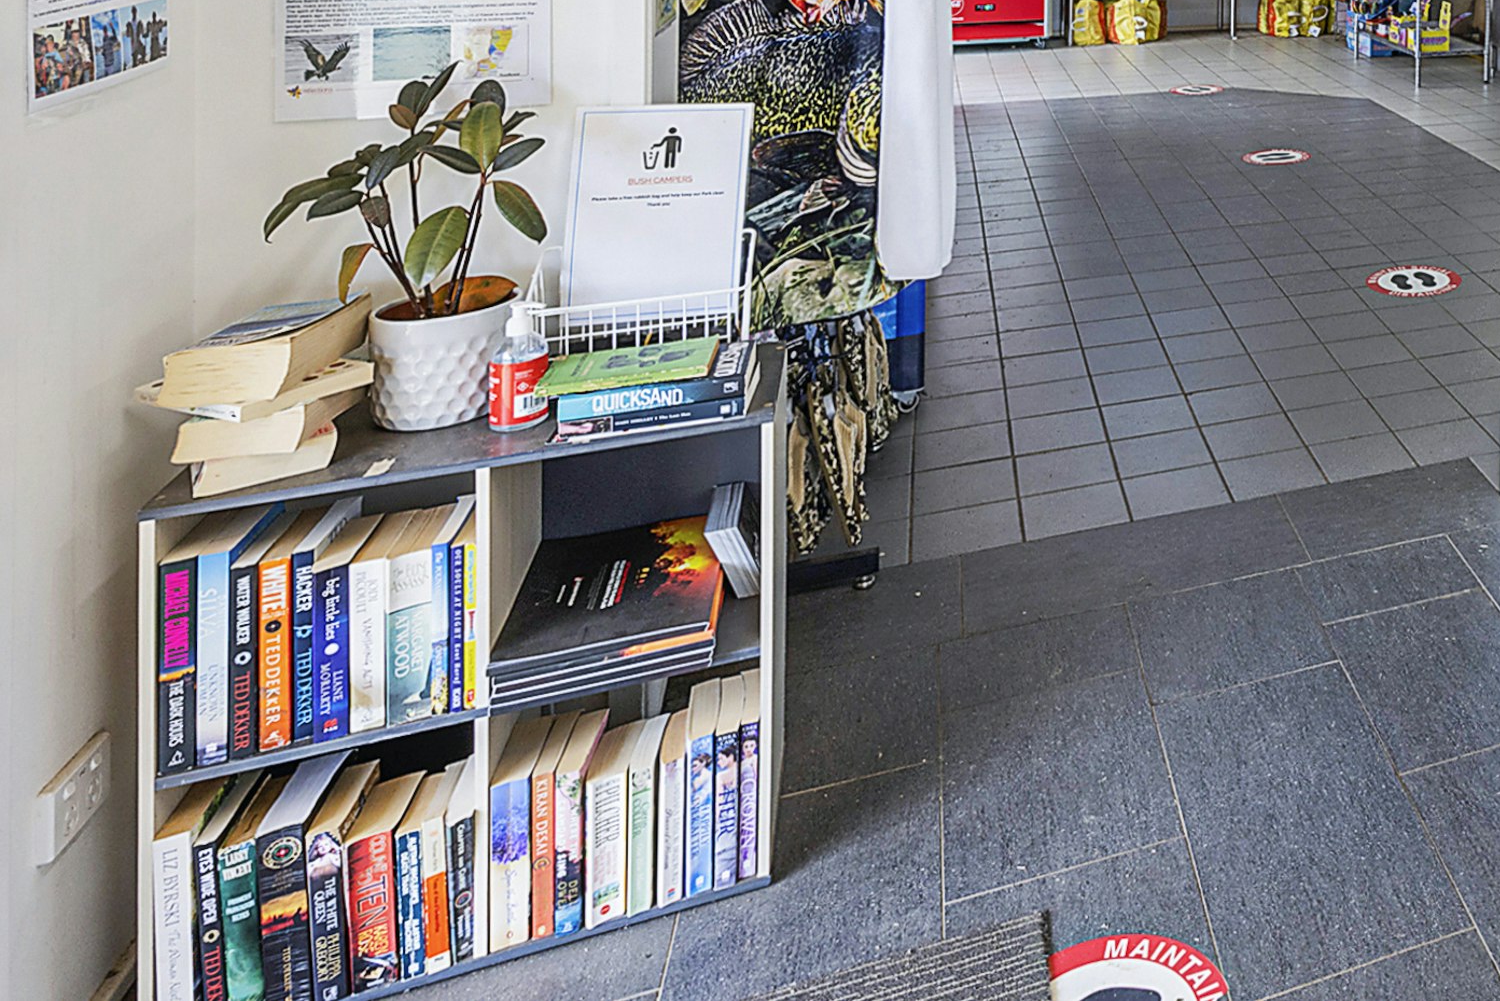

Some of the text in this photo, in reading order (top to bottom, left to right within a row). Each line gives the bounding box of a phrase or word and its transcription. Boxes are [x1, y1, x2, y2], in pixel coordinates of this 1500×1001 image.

[628, 175, 693, 186] BUSH CAMPERS
[592, 388, 684, 412] QUICKSAND
[236, 575, 251, 646] WATER WALKER
[261, 564, 287, 614] WHITE
[296, 566, 312, 613] HACKER
[322, 577, 340, 641] big little lies
[164, 569, 190, 668] MICHAEL CONNELLY
[395, 616, 410, 679] ATWOOD
[169, 680, 184, 697] THE
[265, 635, 281, 726] TED DEKKER
[320, 663, 331, 716] MORIARTY
[333, 670, 343, 702] LIANE
[234, 671, 250, 751] TED DEKKER
[536, 779, 548, 856] KIRAN DESAI
[717, 787, 737, 840] HEIR
[198, 848, 214, 874] EYES
[200, 871, 216, 900] WIDE
[162, 849, 180, 927] LIZ BYRSKI
[324, 876, 338, 931] THE WHITE
[204, 945, 221, 976] TED
[315, 936, 329, 982] GREGORY
[327, 932, 342, 980] PHILIPPA
